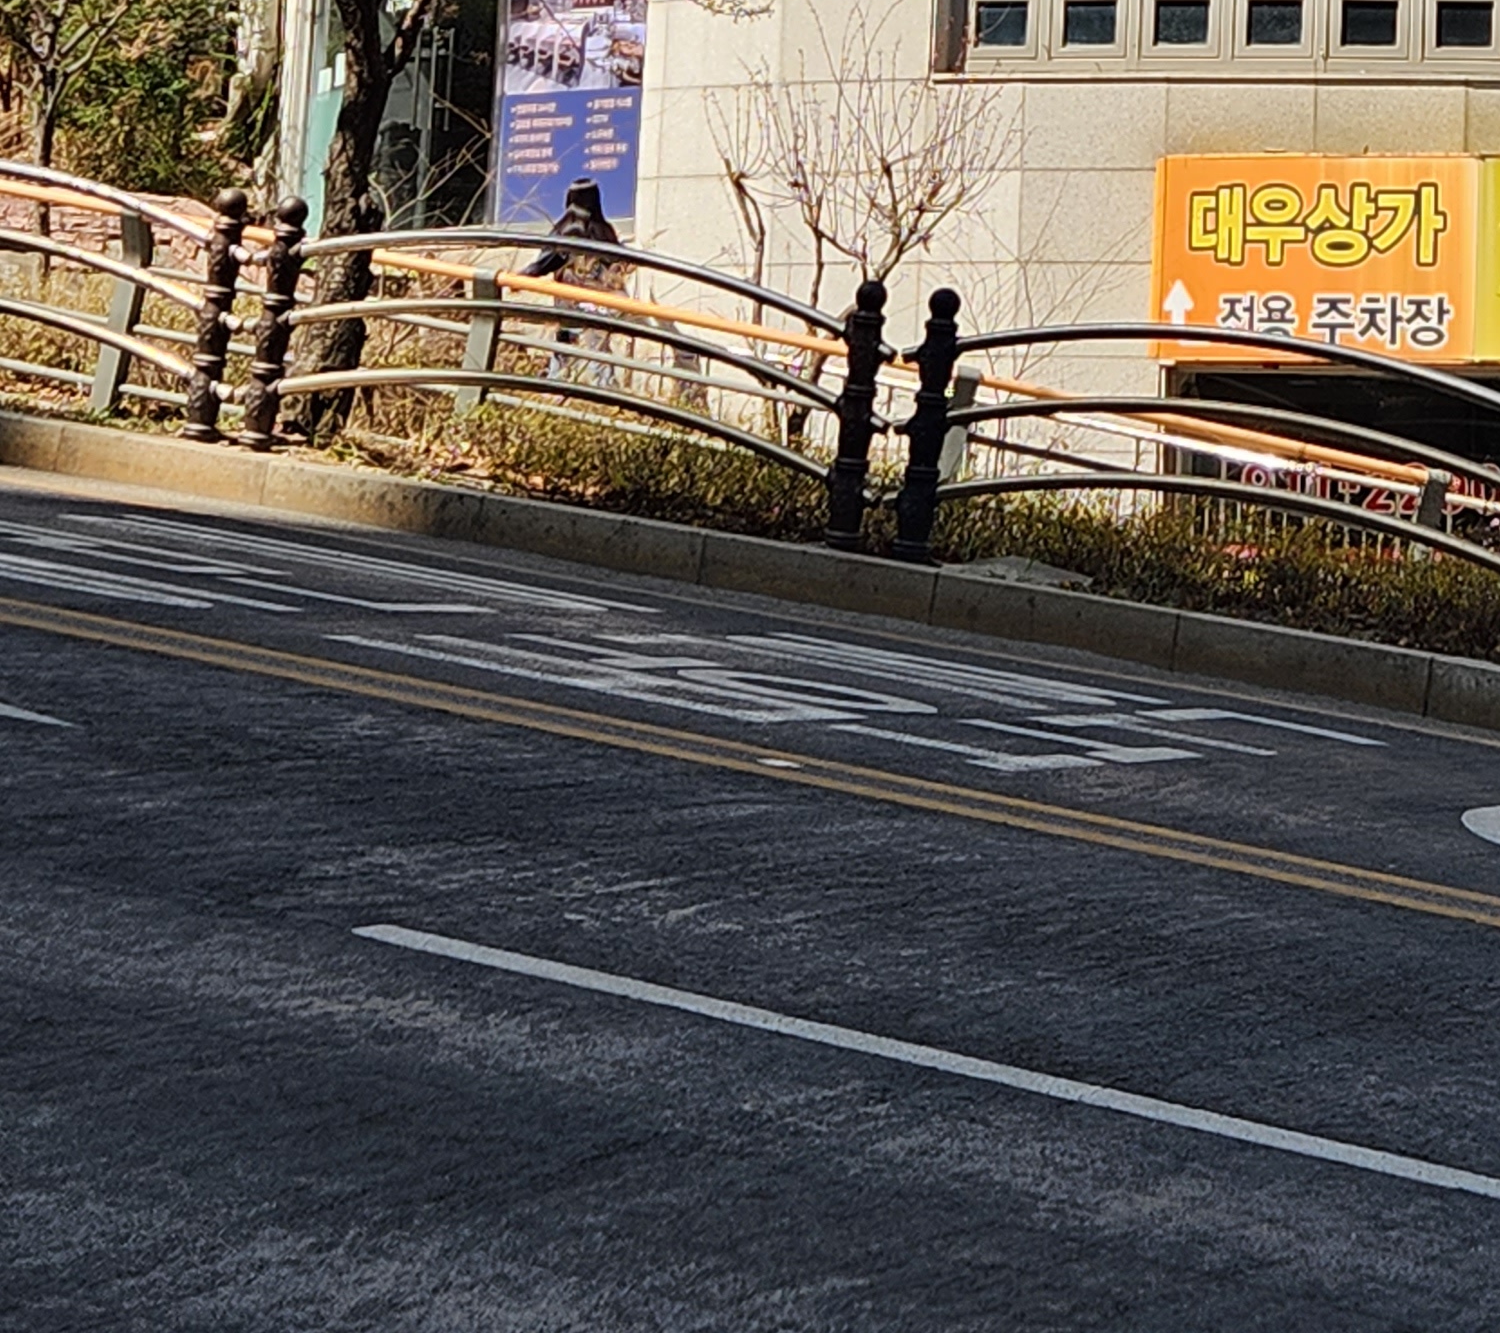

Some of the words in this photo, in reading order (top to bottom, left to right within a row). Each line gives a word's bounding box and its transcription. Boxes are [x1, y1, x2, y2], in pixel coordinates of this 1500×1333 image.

[1188, 178, 1448, 269] 대우상가
[1217, 292, 1299, 338] 전용
[1309, 293, 1450, 350] 주차장
